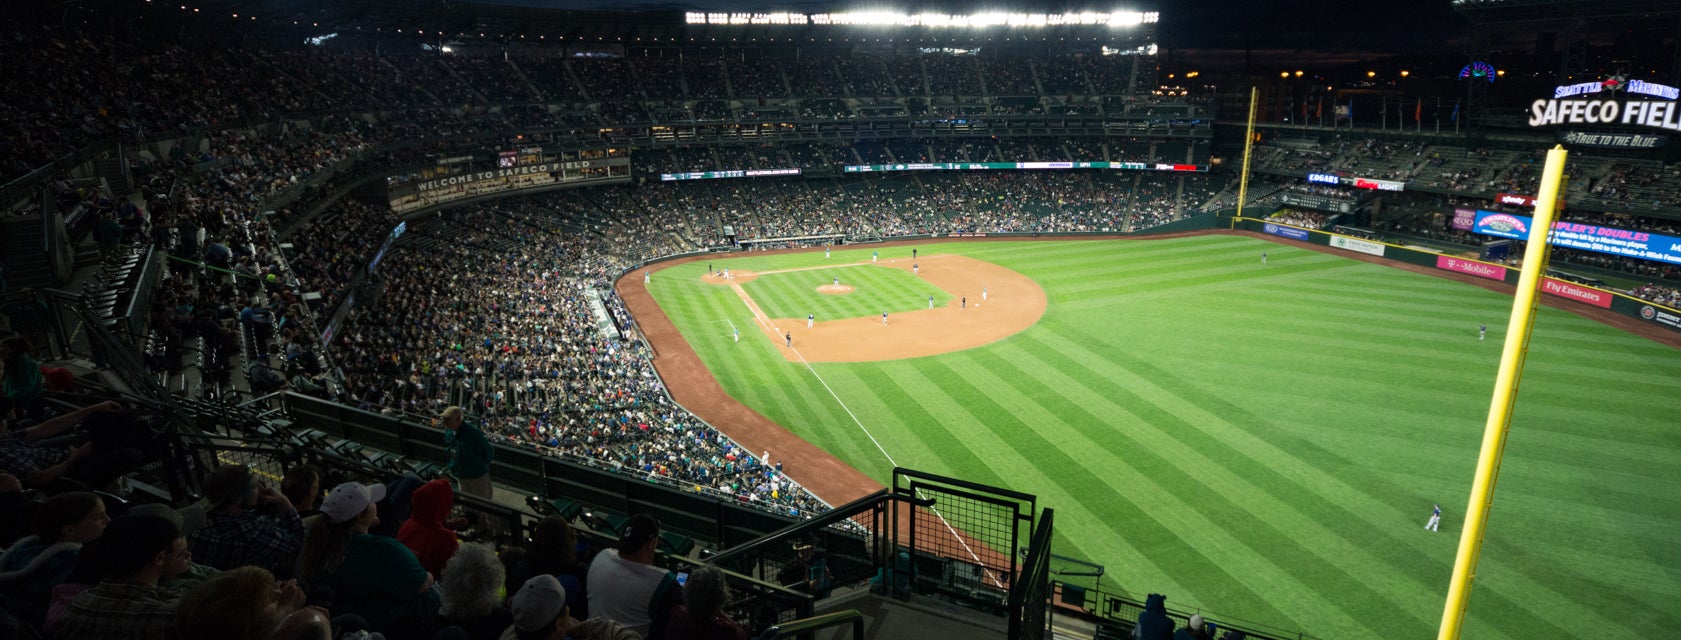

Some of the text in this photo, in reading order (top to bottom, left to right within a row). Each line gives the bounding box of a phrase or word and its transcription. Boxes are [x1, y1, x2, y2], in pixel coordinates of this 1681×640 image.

[1555, 79, 1680, 100] SEATTLE MARINERS
[1528, 99, 1681, 131] SAFECO FIEL
[1575, 132, 1658, 147] TRUE TO THE BLUE
[418, 160, 590, 192] WELCOME TO SAFECO FIELD
[1597, 227, 1649, 242] DOUBLES
[1547, 282, 1600, 301] Fly Emirates
